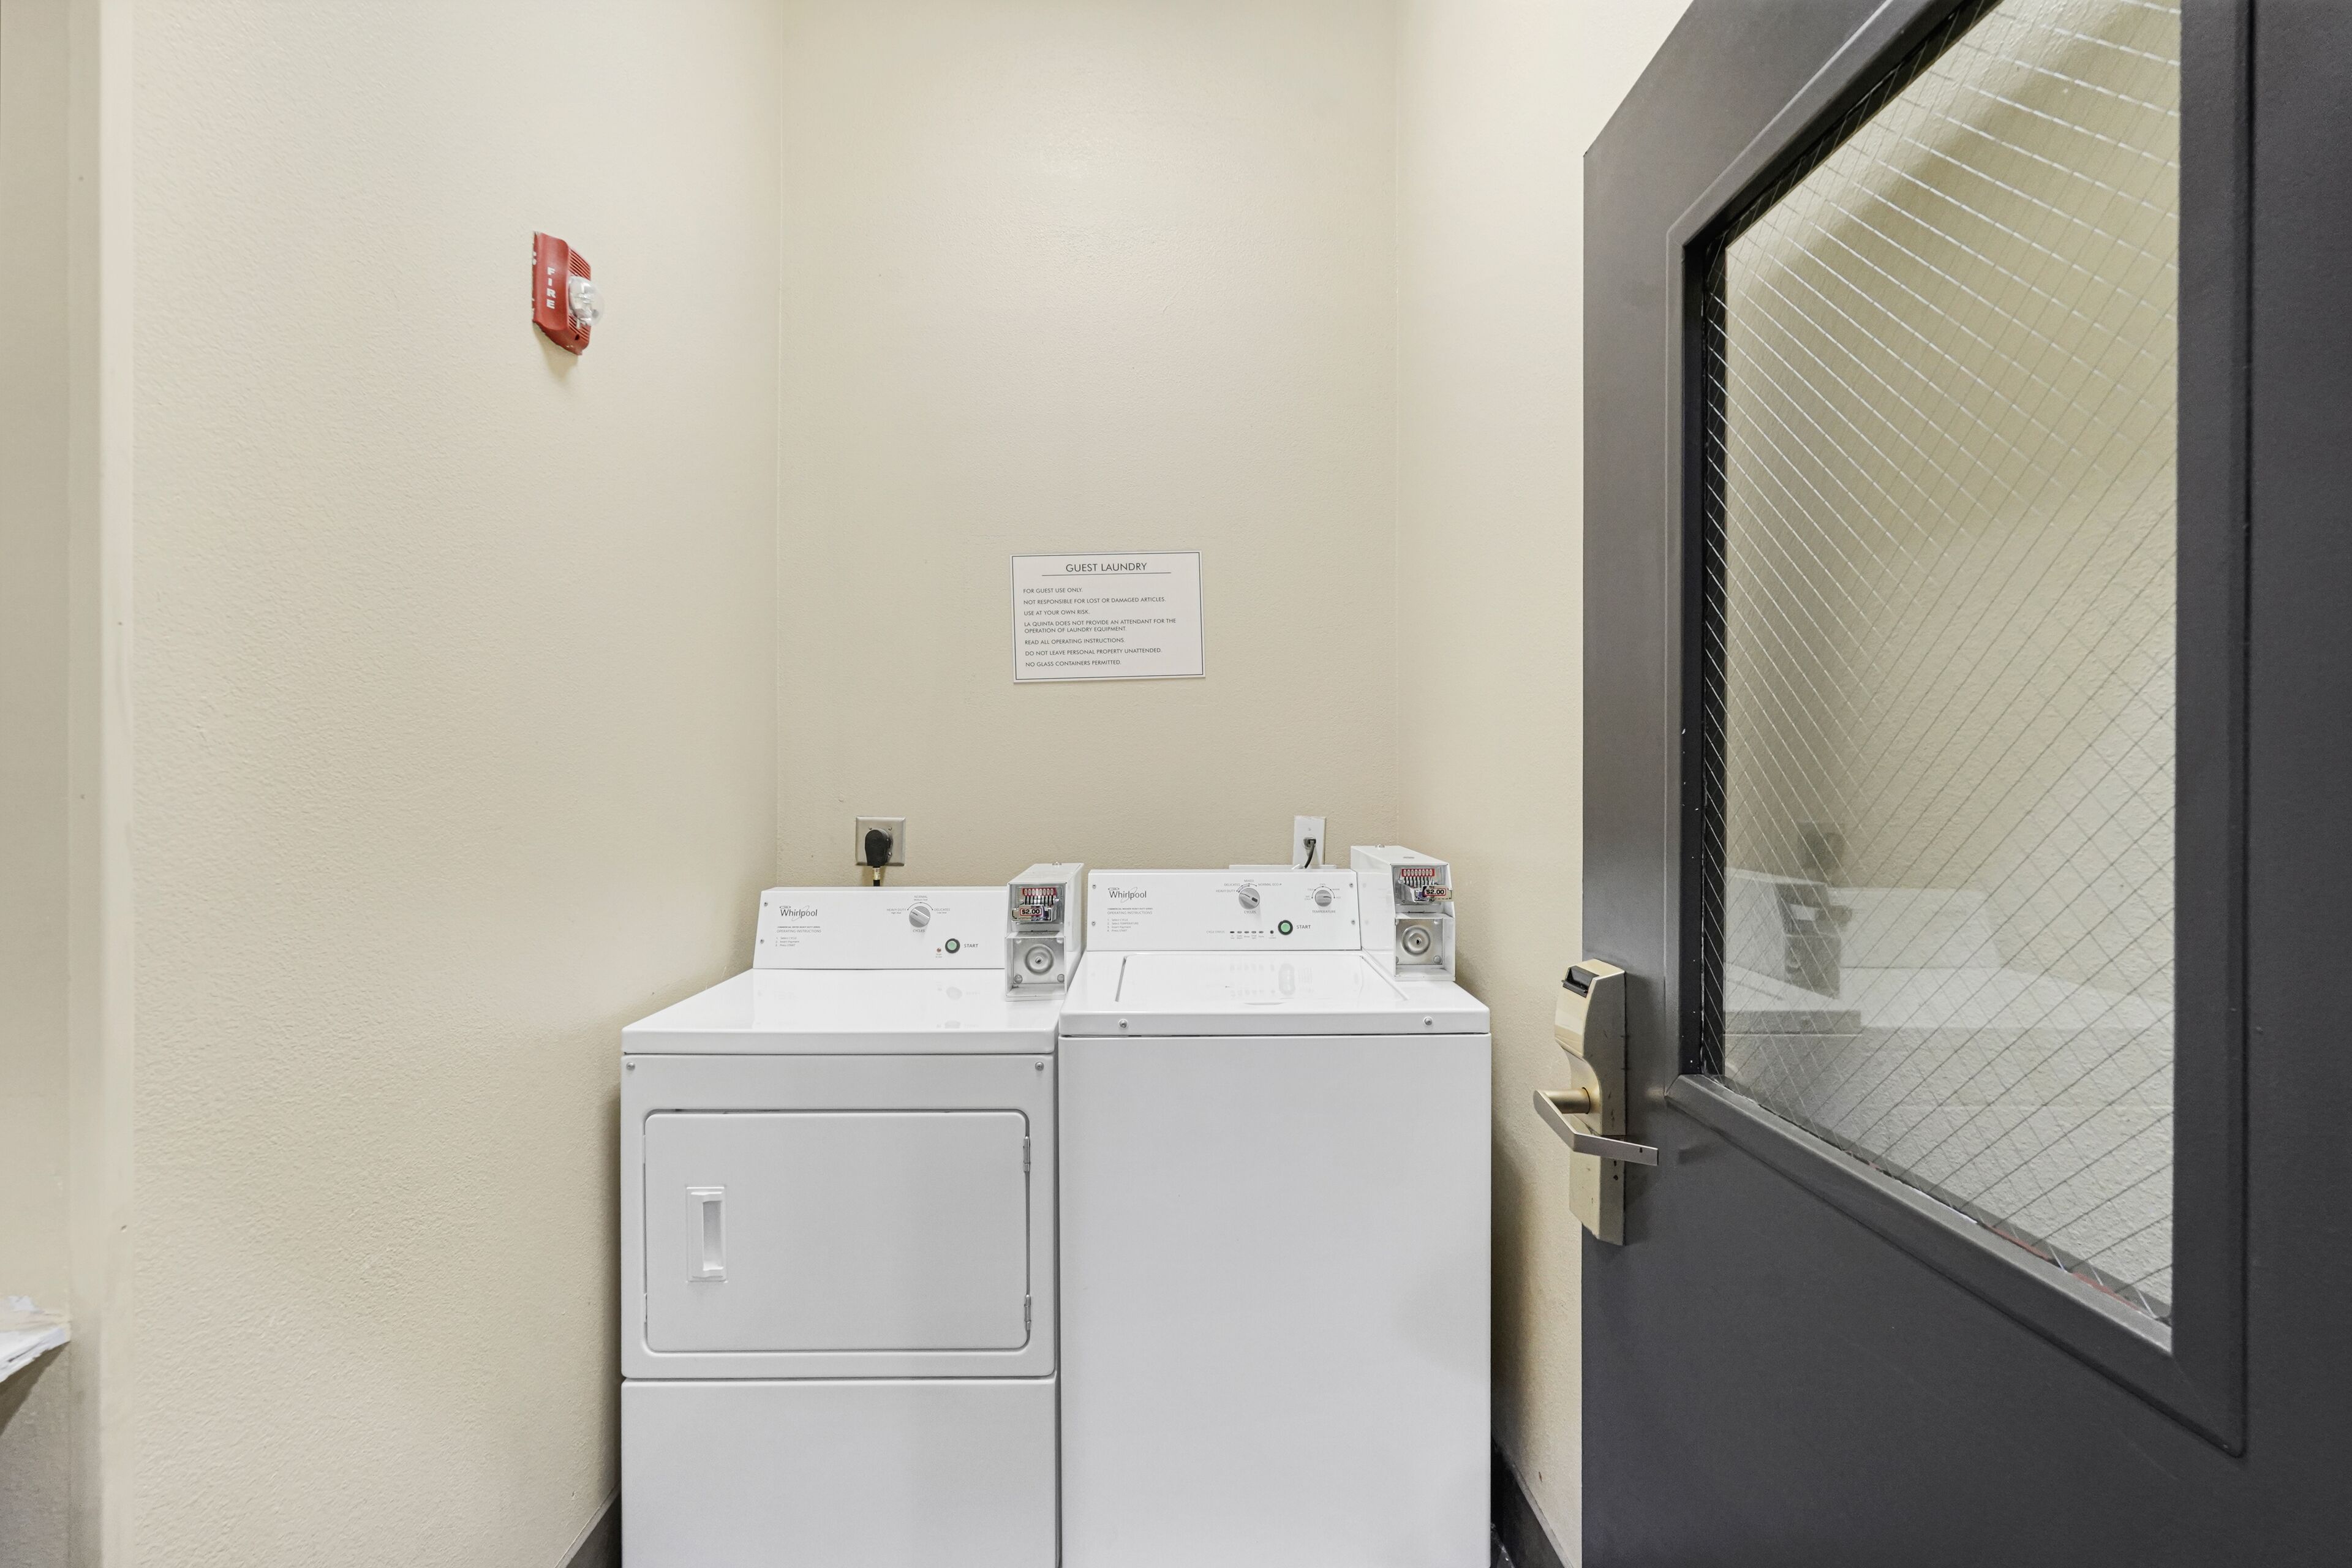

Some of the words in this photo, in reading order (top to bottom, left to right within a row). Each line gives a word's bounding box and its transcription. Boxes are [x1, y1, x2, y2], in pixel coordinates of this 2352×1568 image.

[546, 266, 556, 309] FIRE
[1066, 564, 1098, 572] GUEST
[1101, 562, 1147, 571] LAUNDRY
[1109, 891, 1147, 900] Whirlpool
[780, 909, 818, 918] Whirlpool
